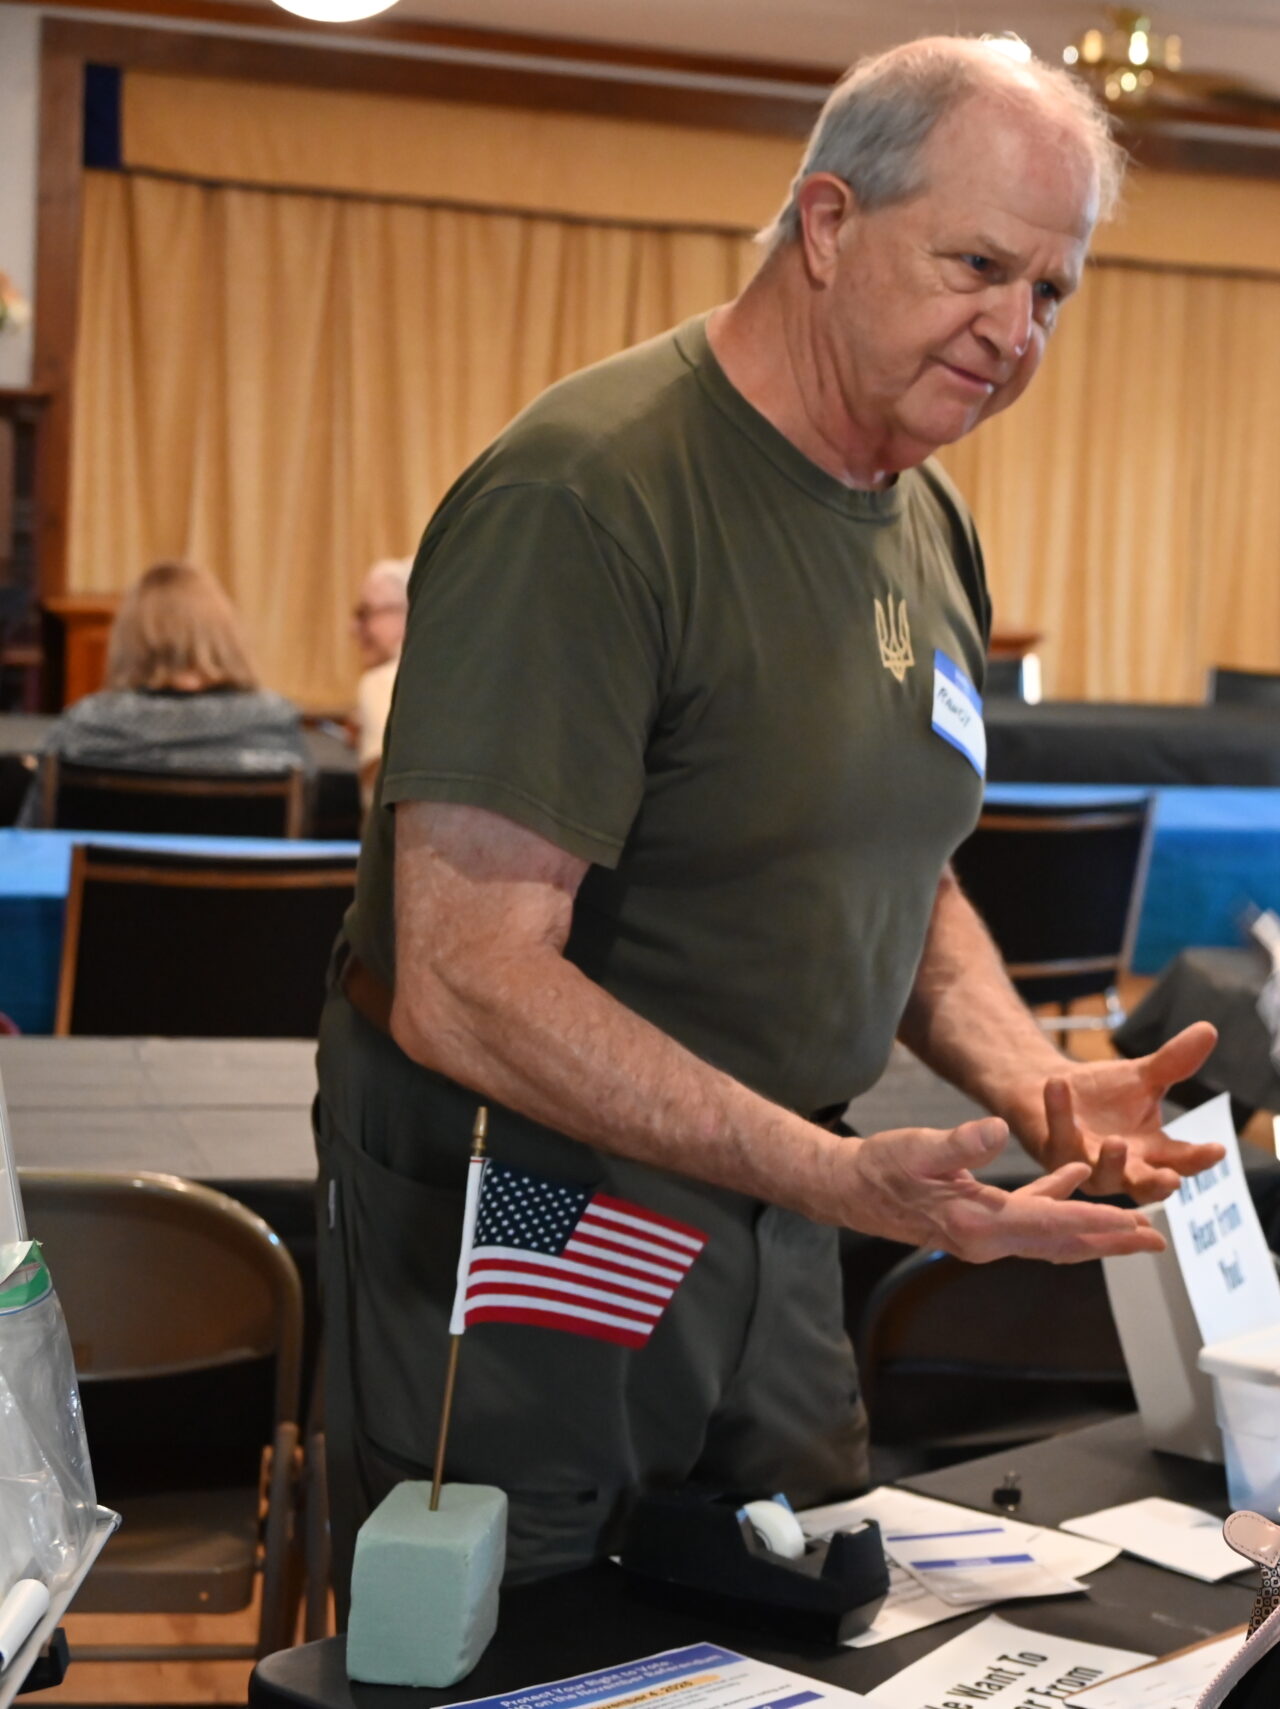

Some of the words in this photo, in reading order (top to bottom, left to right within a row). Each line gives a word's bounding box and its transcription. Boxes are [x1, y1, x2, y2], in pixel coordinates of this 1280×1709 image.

[500, 1691, 555, 1707] Protect
[551, 1684, 585, 1694] Your
[584, 1674, 620, 1686] Right
[620, 1670, 638, 1678] to
[534, 1700, 553, 1708] on
[552, 1694, 577, 1702] the
[576, 1675, 644, 1696] November
[643, 1654, 722, 1678] Referendum
[946, 1666, 1026, 1700] Want
[996, 1651, 1048, 1668] To
[1026, 1666, 1104, 1700] From
